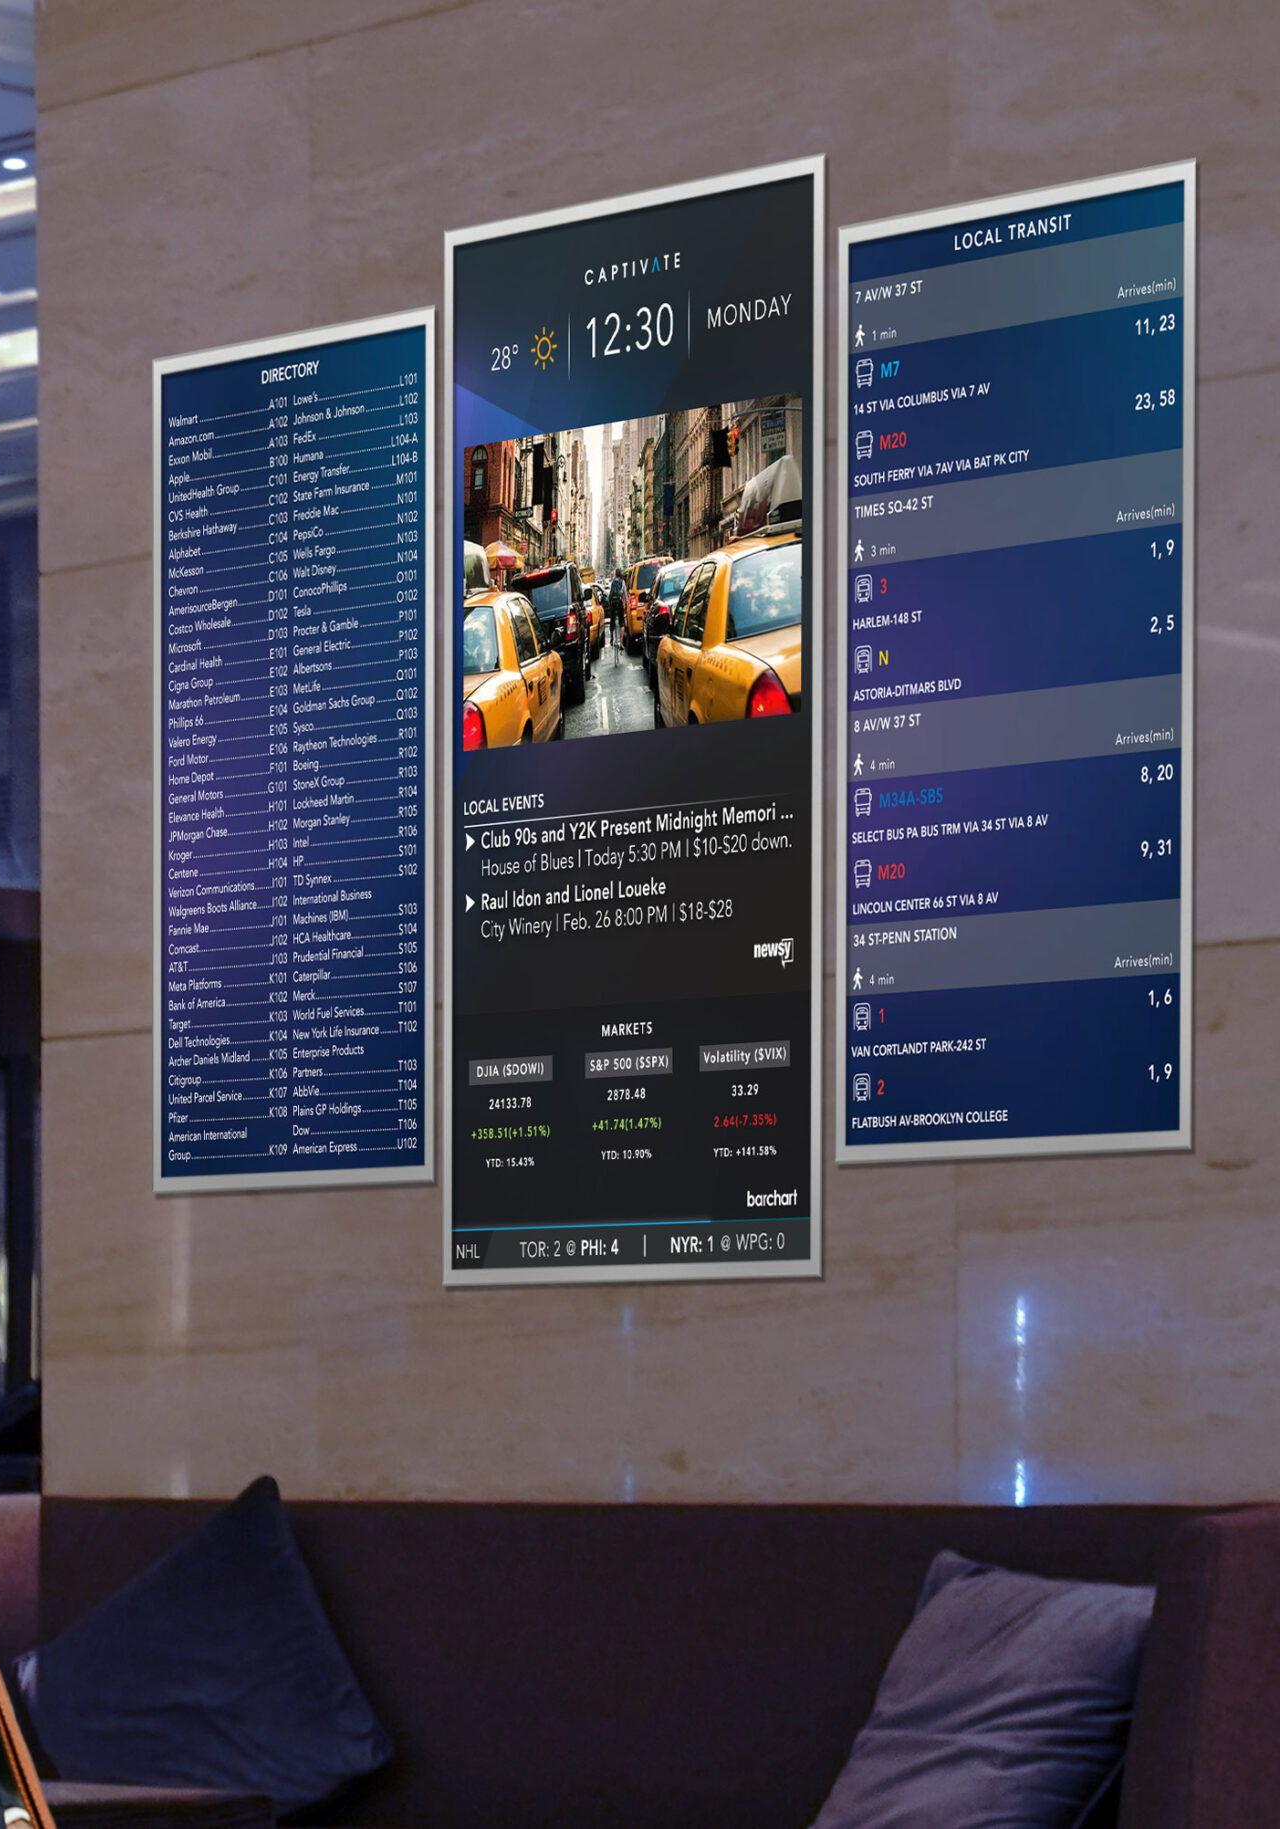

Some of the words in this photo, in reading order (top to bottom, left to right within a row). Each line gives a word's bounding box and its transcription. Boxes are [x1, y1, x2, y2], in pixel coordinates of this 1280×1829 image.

[954, 227, 1002, 250] LOCAL
[1007, 213, 1071, 240] TRANSIT
[854, 291, 862, 303] 7
[864, 285, 892, 302] AV/W
[895, 282, 907, 296] 37
[910, 280, 922, 294] ST
[1117, 277, 1176, 298] Arrives(min)
[707, 293, 791, 328] MONDAY
[586, 302, 673, 358] 12:30
[1135, 318, 1154, 335] 11,
[1159, 313, 1175, 331] 23
[871, 330, 877, 341] 1
[880, 327, 896, 339] min
[261, 361, 319, 384] DIRECTORY
[881, 360, 899, 378] M7
[853, 403, 864, 415] 14
[866, 400, 877, 413] ST
[879, 398, 894, 410] VIA
[897, 389, 948, 408] COLUMBUS
[950, 386, 966, 399] VIA
[968, 384, 975, 396] 7
[977, 382, 990, 395] AV
[1135, 392, 1154, 410] 23,
[1159, 388, 1175, 406] 58
[168, 414, 198, 427] Walmart
[293, 430, 316, 444] FedEx
[879, 431, 906, 450] M20
[293, 490, 312, 502] State
[314, 486, 333, 498] Farm
[334, 481, 369, 494] Insurance
[168, 509, 183, 522] CVS
[185, 505, 207, 519] Health
[293, 507, 321, 520] Freddie
[323, 504, 339, 516] Mac
[854, 502, 884, 518] TIMES
[888, 497, 917, 514] SQ-42
[921, 495, 933, 509] ST
[1116, 503, 1174, 522] Arrives(min)
[852, 612, 908, 630] HARLEM-148
[911, 610, 922, 622] ST
[168, 638, 201, 653] Microsoft
[168, 658, 197, 673] Cardinal
[199, 655, 222, 668] Health
[853, 680, 935, 701] ASTORIA-DITMARS
[938, 678, 961, 691] BLVD
[1115, 728, 1173, 745] Arrives(min)
[463, 798, 499, 815] LOCAL
[502, 793, 544, 811] EVENTS
[879, 787, 943, 808] M34A-SBS
[481, 828, 510, 849] Club
[514, 827, 537, 845] 90s
[541, 822, 564, 843] and
[569, 820, 596, 840] Y2K
[601, 817, 651, 837] Present
[656, 808, 717, 833] Midnight
[481, 859, 519, 876] House
[523, 852, 537, 872] of
[541, 852, 574, 871] Blues
[584, 846, 624, 869] Today
[628, 842, 656, 862] 5:30
[661, 840, 680, 858] PM
[693, 833, 747, 857] $10-$20
[751, 831, 791, 851] down.
[878, 863, 905, 880] M20
[292, 890, 338, 905] International
[340, 889, 372, 901] Business
[481, 890, 507, 910] Raul
[513, 888, 540, 907] Idon
[545, 884, 569, 904] and
[574, 880, 613, 902] Lionel
[618, 876, 666, 898] Loueke
[852, 900, 892, 915] LINCOLN
[894, 897, 930, 911] CENTER
[932, 896, 943, 908] 66
[946, 895, 957, 907] ST
[959, 894, 975, 905] VIA
[976, 892, 984, 904] 8
[985, 891, 998, 904] AV
[480, 920, 505, 941] City
[508, 917, 552, 938] Winery
[563, 911, 590, 930] Feb.
[595, 910, 610, 928] 26
[614, 906, 642, 926] 8:00
[647, 904, 667, 923] PM
[679, 899, 732, 921] $18-$28
[853, 934, 865, 947] 34
[868, 930, 910, 946] ST-PENN
[913, 926, 956, 942] STATION
[754, 938, 793, 963] newsy
[1114, 952, 1172, 968] Arrives(min)
[601, 1021, 652, 1036] MARKETS
[292, 1047, 329, 1060] Enterprise
[332, 1043, 364, 1055] Products
[703, 1049, 750, 1064] Volatility
[754, 1047, 786, 1062] ($VIX)
[851, 1045, 870, 1057] VAN
[872, 1041, 928, 1056] CORTLANDT
[930, 1039, 973, 1052] PARK-242
[975, 1038, 986, 1050] ST
[292, 1066, 323, 1077] Partners
[476, 1065, 499, 1077] DJIA
[502, 1062, 543, 1077] ($DOWI)
[590, 1058, 609, 1071] S&P
[613, 1057, 631, 1070] 500
[635, 1055, 668, 1070] ($SPX)
[607, 1087, 645, 1100] 2878.48
[731, 1083, 758, 1096] 33.29
[488, 1096, 531, 1109] 24133.78
[852, 1115, 896, 1128] FLATBUSH
[898, 1112, 963, 1126] AV-BROOKLYN
[965, 1109, 1008, 1123] COLLEGE
[168, 1131, 201, 1142] American
[203, 1127, 247, 1140] International
[292, 1143, 326, 1154] American
[329, 1141, 357, 1155] Express
[601, 1150, 619, 1160] YTD:
[623, 1148, 652, 1159] 10.90%
[713, 1147, 732, 1157] YTD:
[735, 1145, 776, 1156] +141.58%
[485, 1158, 503, 1167] YTD:
[506, 1156, 534, 1167] 15.43%
[747, 1189, 797, 1207] barchart
[456, 1243, 480, 1258] NHL
[519, 1241, 549, 1257] TOR:
[553, 1240, 561, 1256] 2
[581, 1239, 606, 1256] PHI:
[610, 1238, 618, 1255] 4
[670, 1236, 702, 1253] NYR:
[706, 1235, 713, 1252] 1
[736, 1232, 772, 1250] WPG:
[776, 1232, 784, 1249] 0
